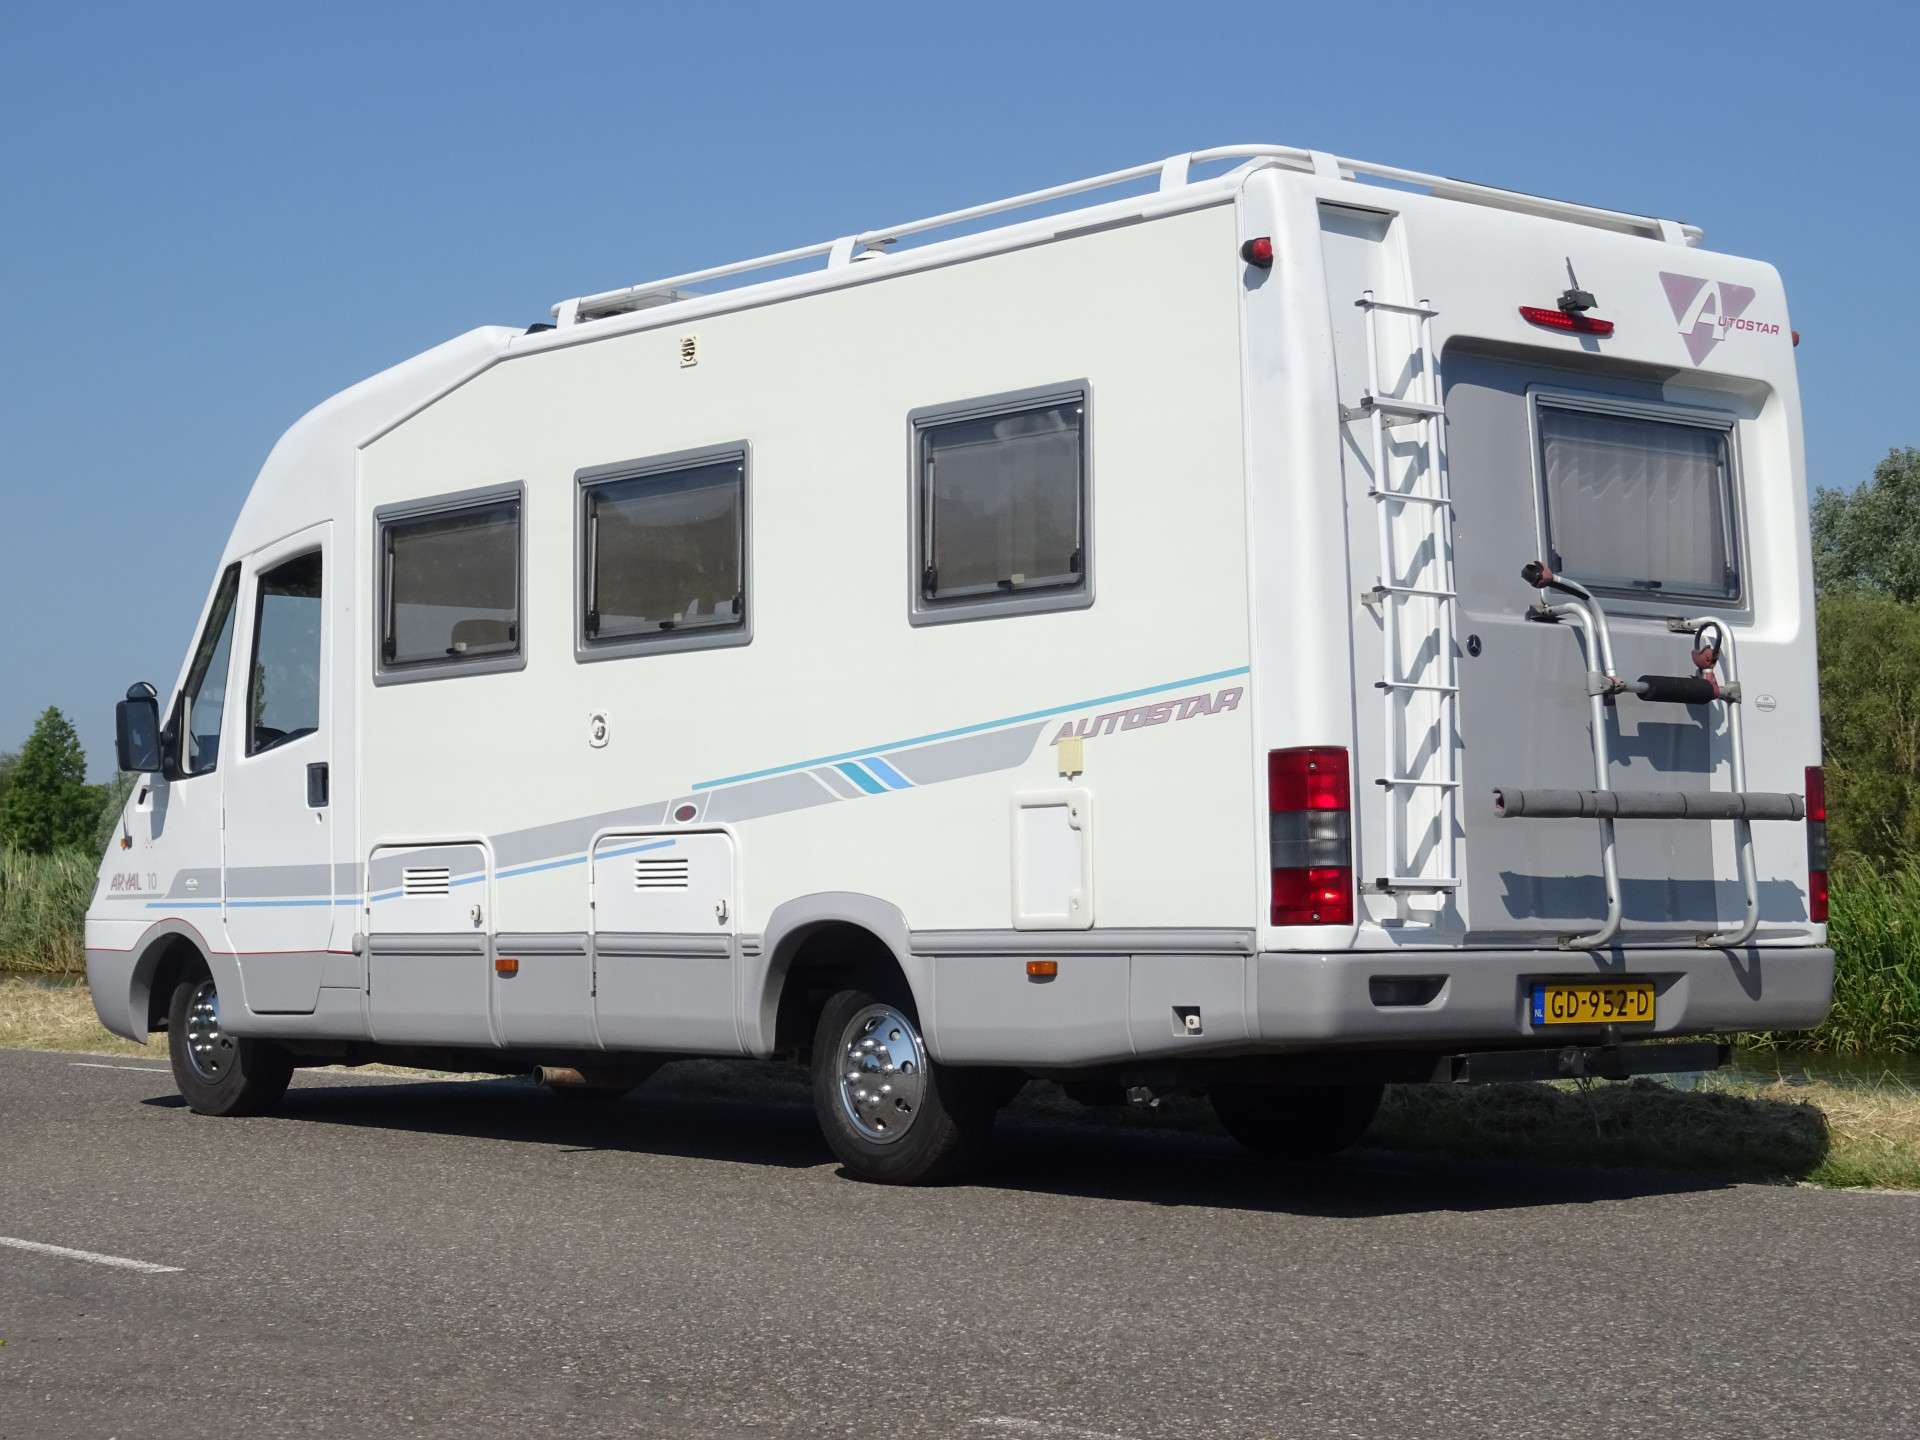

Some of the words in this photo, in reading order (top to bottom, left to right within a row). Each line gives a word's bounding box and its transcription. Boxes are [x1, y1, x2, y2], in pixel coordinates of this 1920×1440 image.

[1049, 687, 1244, 746] AUTOSTAR
[146, 872, 157, 890] 10
[1534, 1009, 1543, 1018] NL
[1551, 989, 1649, 1018] GD-952-D
